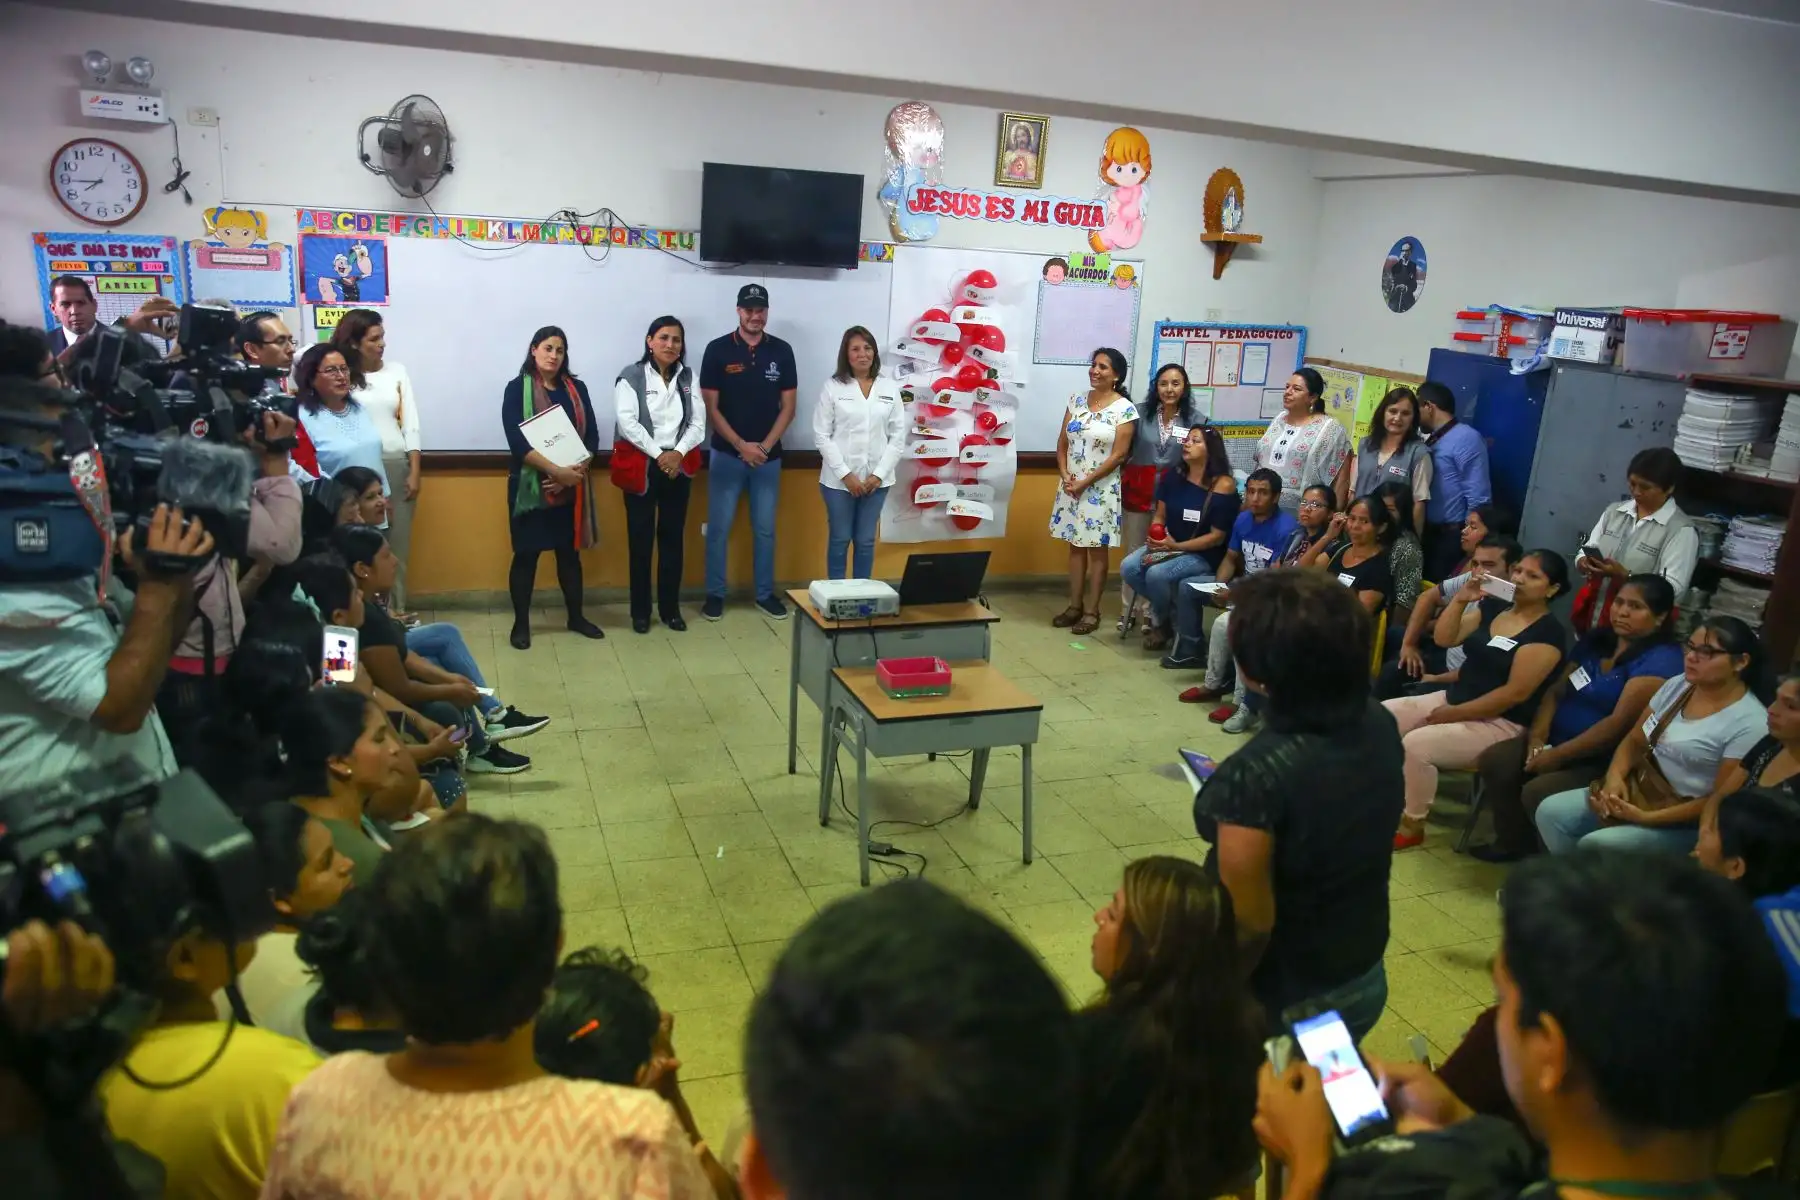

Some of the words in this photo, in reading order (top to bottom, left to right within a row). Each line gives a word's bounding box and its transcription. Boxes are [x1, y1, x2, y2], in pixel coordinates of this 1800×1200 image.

[74, 150, 85, 161] 11
[88, 146, 105, 157] 12
[111, 152, 116, 162] 1
[63, 161, 78, 172] 10
[121, 163, 132, 174] 2
[60, 173, 71, 185] 9
[127, 178, 138, 190] 3
[66, 189, 78, 200] 8
[122, 193, 132, 204] 4
[81, 201, 92, 212] 7
[97, 206, 108, 218] 6
[114, 203, 124, 214] 5
[985, 195, 1015, 220] ES
[1020, 199, 1050, 223] MI
[108, 244, 128, 258] ES
[131, 245, 161, 258] HOY
[1082, 255, 1096, 267] MIS
[1068, 267, 1108, 280] ACUERDOS
[105, 282, 147, 290] ABRIL
[1556, 311, 1607, 329] Universal
[1160, 327, 1210, 339] CARTEL
